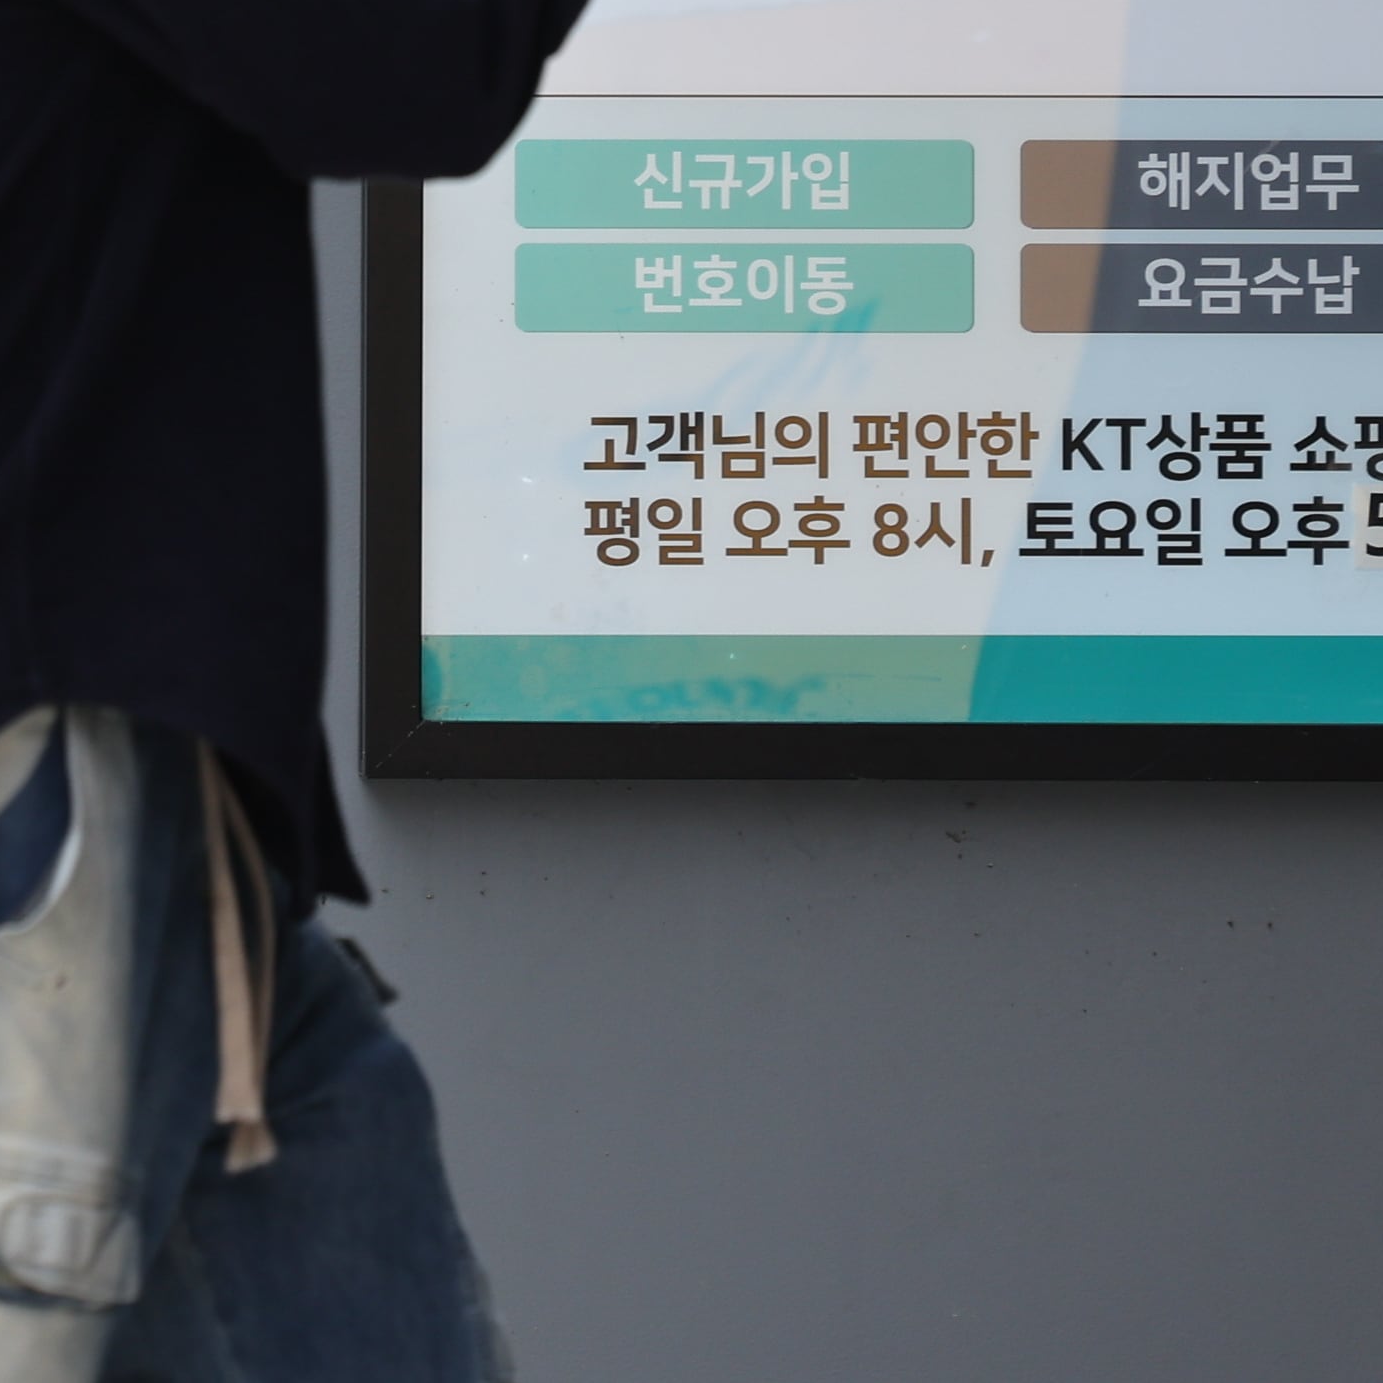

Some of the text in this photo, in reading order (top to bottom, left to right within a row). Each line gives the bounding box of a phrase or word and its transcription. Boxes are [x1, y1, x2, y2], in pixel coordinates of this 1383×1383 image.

[634, 151, 852, 212] 신규가입
[1137, 152, 1360, 212] 해지업무
[635, 255, 854, 316] 번호이동
[1137, 255, 1361, 317] 요금수납
[583, 411, 829, 481] 고객님의
[853, 411, 1040, 481] 편안한
[1061, 411, 1272, 482] KT상품
[583, 495, 705, 567] 평일
[725, 495, 850, 563] 오후
[871, 496, 995, 568] 8시,
[1018, 497, 1203, 567] 토요일
[1224, 497, 1350, 567] 오후
